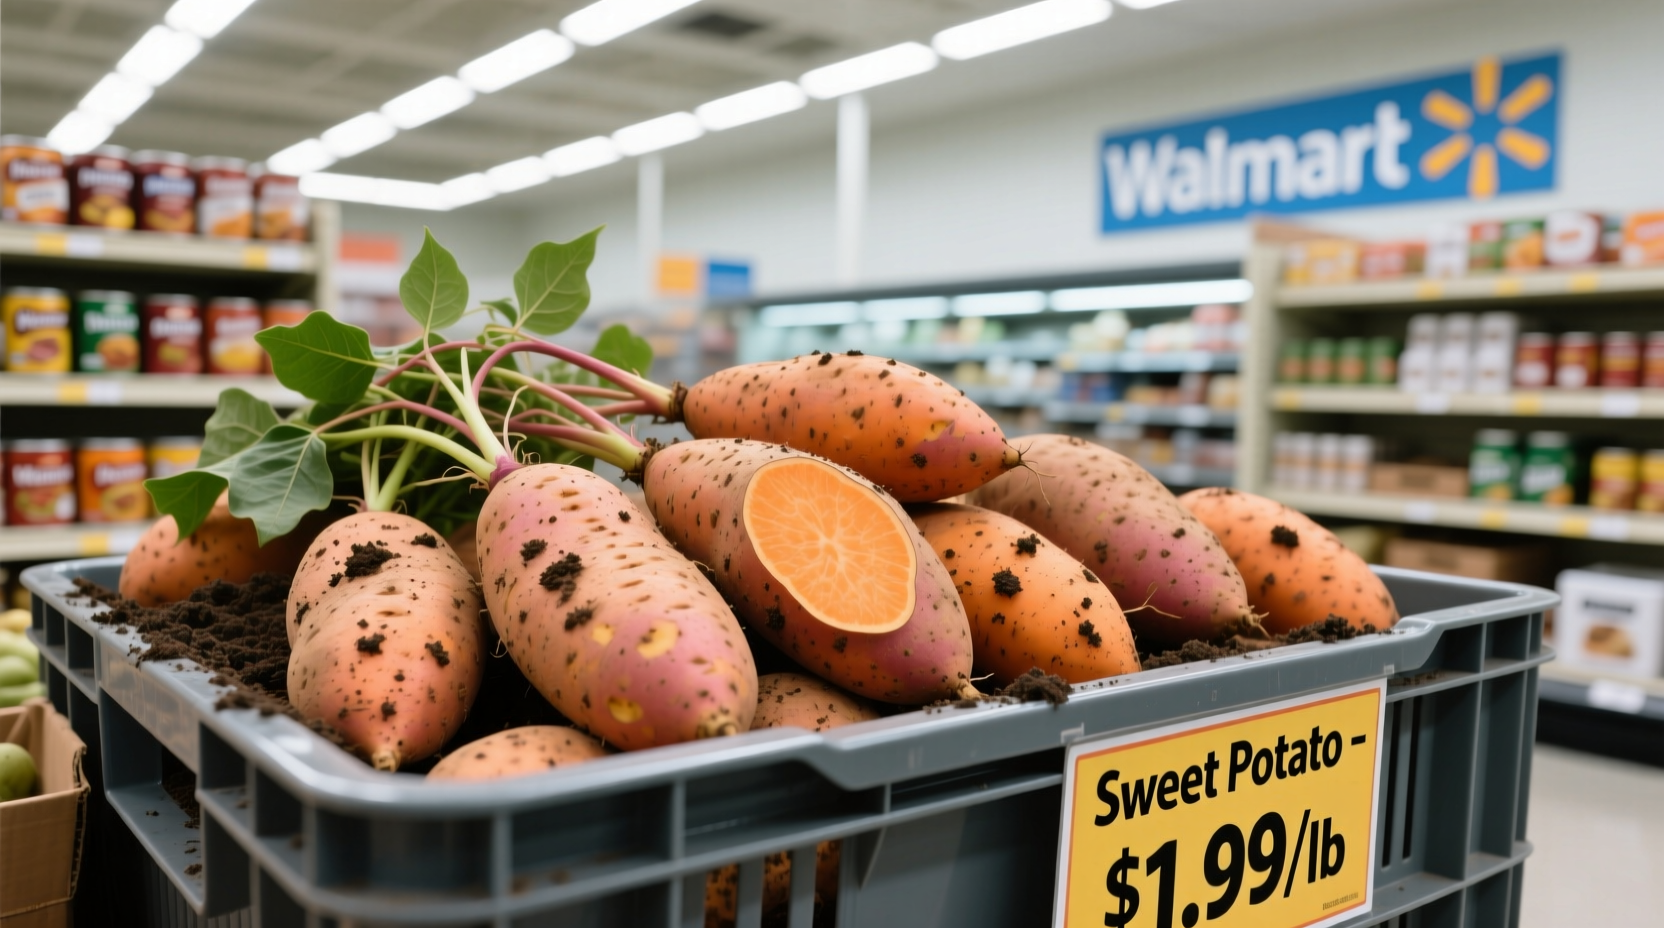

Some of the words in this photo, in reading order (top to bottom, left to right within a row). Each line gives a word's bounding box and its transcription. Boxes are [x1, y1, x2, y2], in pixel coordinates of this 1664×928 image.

[1105, 101, 1411, 219] Walmart
[1094, 751, 1220, 827] Sweet
[1227, 725, 1343, 793] Potato
[1104, 808, 1346, 928] $1.99/lb
